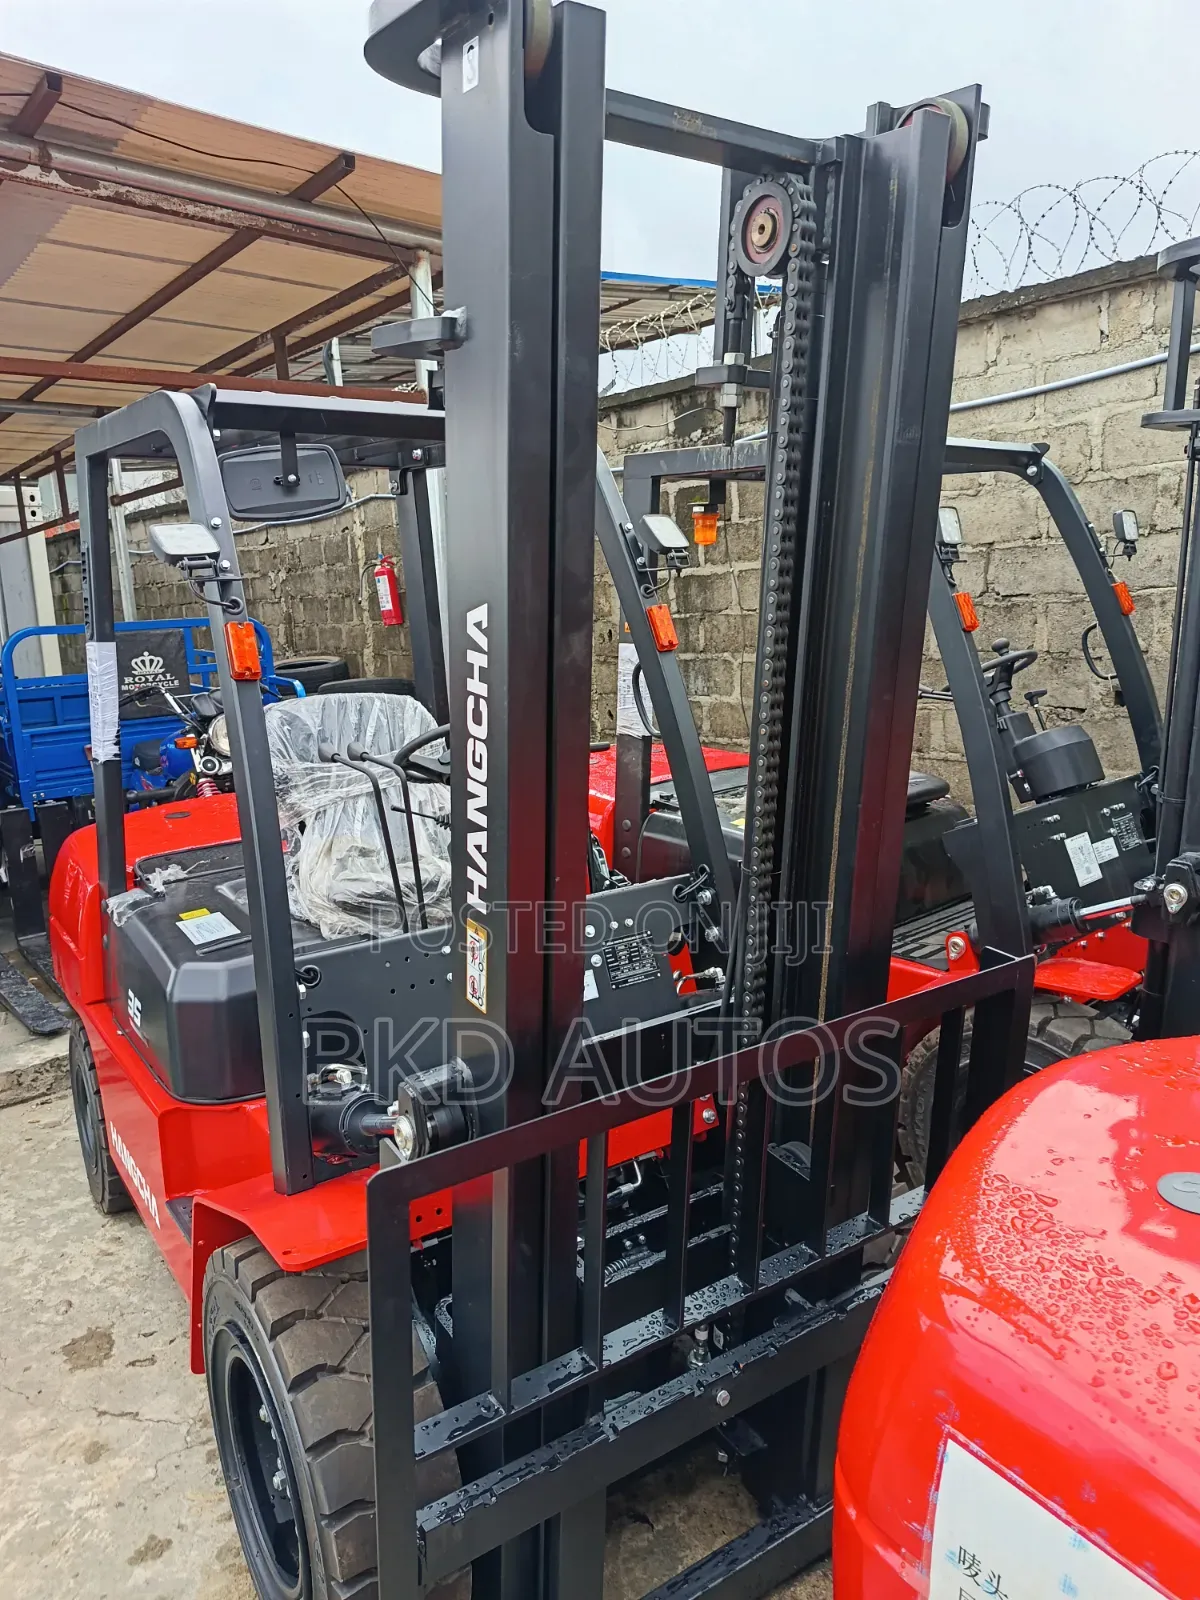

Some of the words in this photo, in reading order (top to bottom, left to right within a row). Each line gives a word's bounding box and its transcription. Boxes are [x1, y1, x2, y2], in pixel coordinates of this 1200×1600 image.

[121, 679, 180, 691] MOTORCYCLE
[123, 673, 176, 684] ROYAL
[467, 603, 488, 915] HANGCHA
[127, 988, 142, 1028] 35
[109, 1120, 160, 1230] HANGCHA
